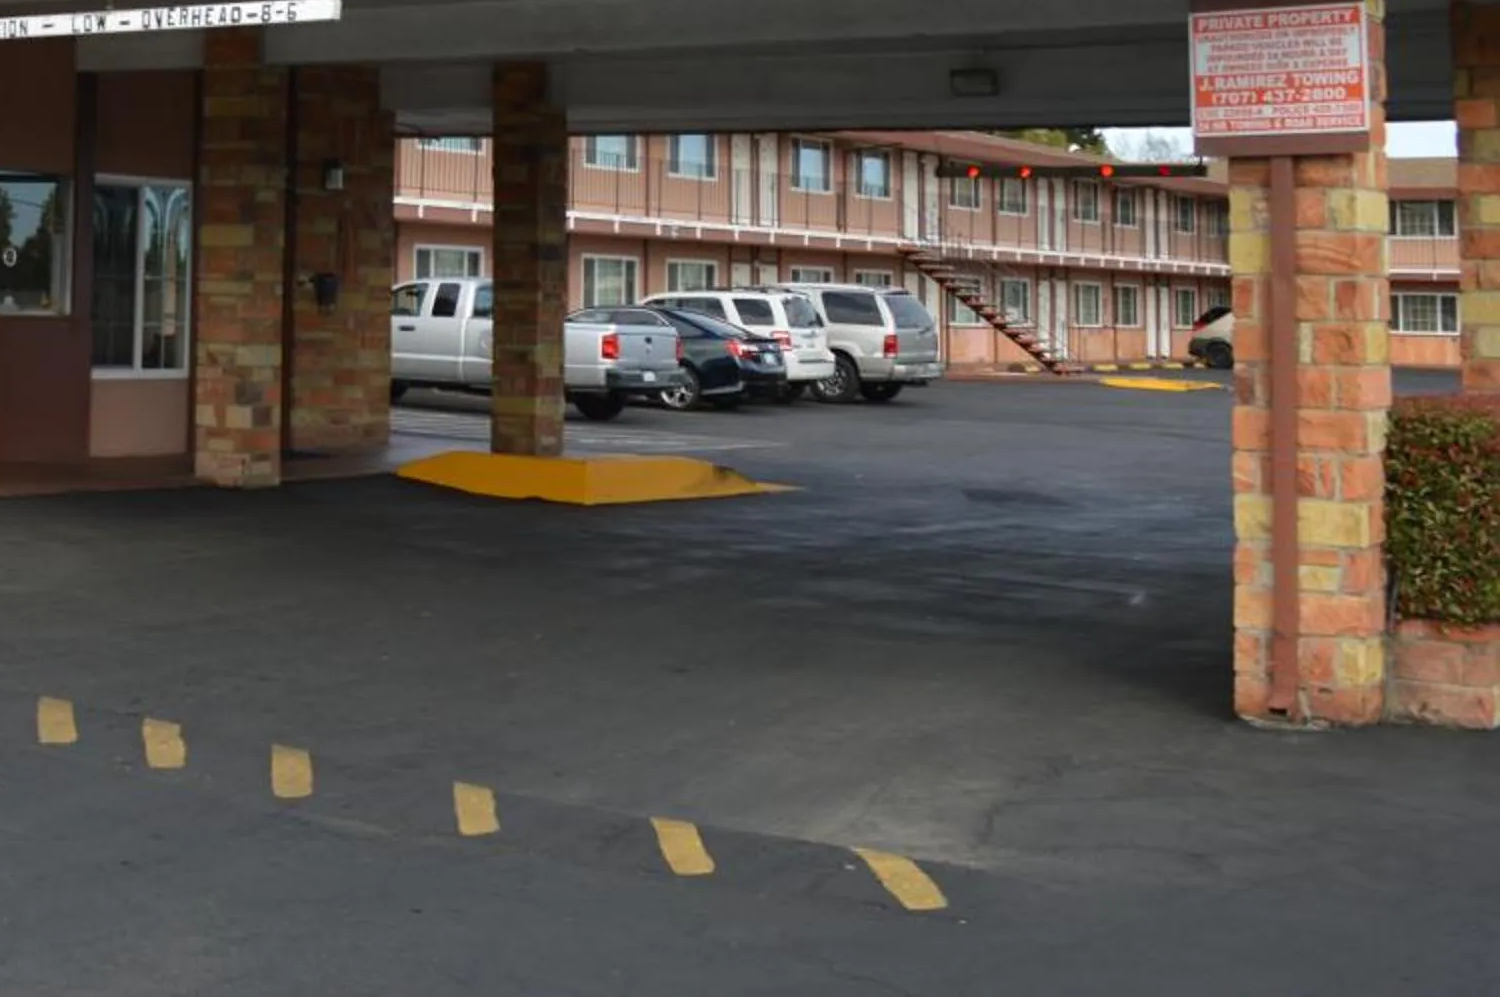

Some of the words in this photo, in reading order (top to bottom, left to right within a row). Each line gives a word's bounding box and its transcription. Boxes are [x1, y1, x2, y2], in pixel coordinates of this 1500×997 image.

[71, 13, 107, 35] LOW
[1197, 15, 1263, 32] PRIVATE
[1266, 9, 1353, 27] PROPERTY
[1291, 70, 1359, 87] TOWING
[1212, 90, 1258, 104] (707)
